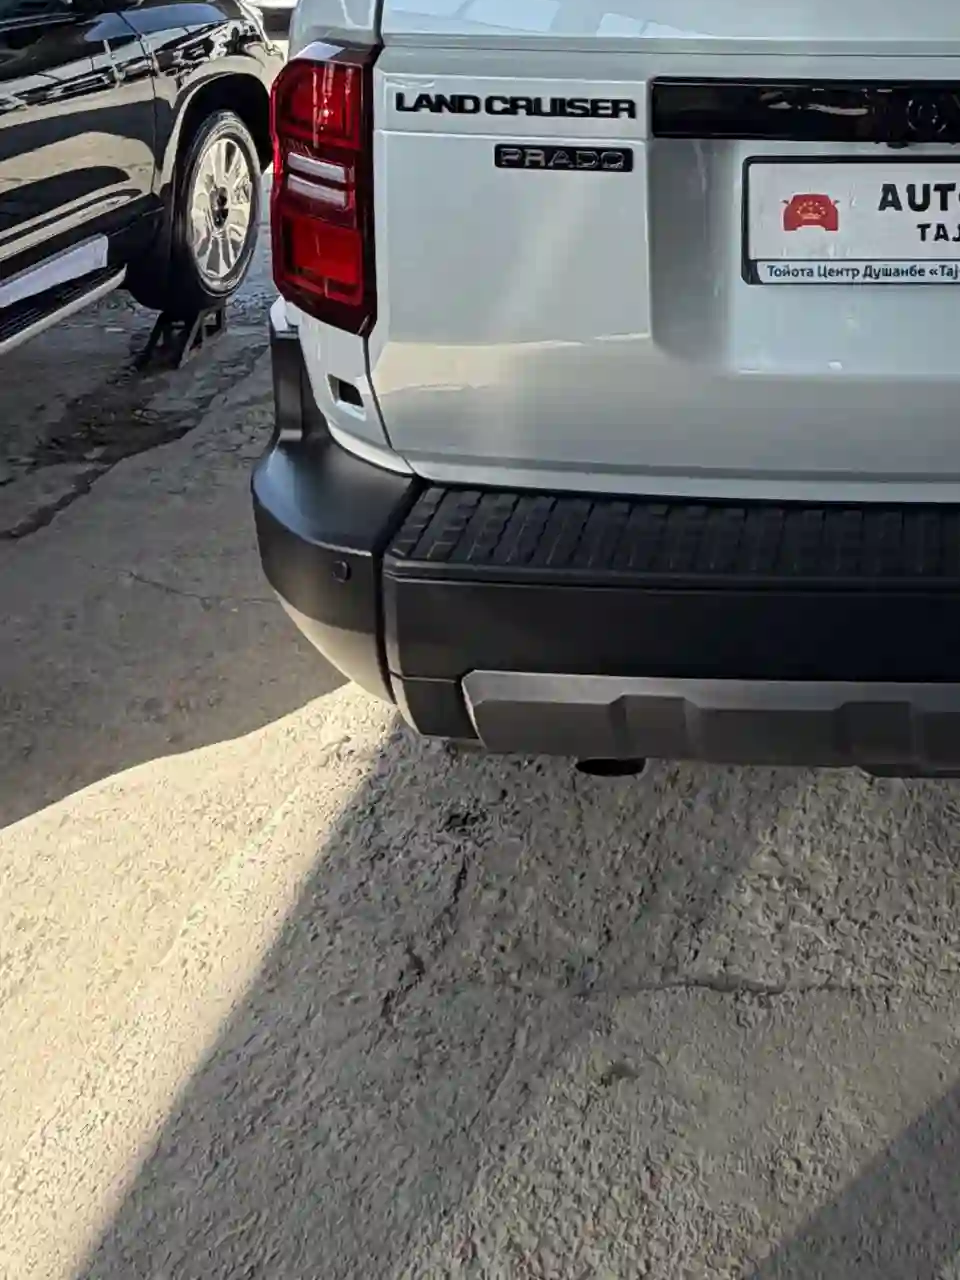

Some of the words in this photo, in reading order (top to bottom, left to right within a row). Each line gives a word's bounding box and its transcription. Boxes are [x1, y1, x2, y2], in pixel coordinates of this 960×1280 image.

[395, 92, 481, 114] LAND
[484, 95, 637, 119] CRUISER
[499, 147, 625, 170] PRADO
[767, 264, 815, 277] Тойота
[817, 264, 860, 280] Центр
[863, 263, 926, 280] Душанбе
